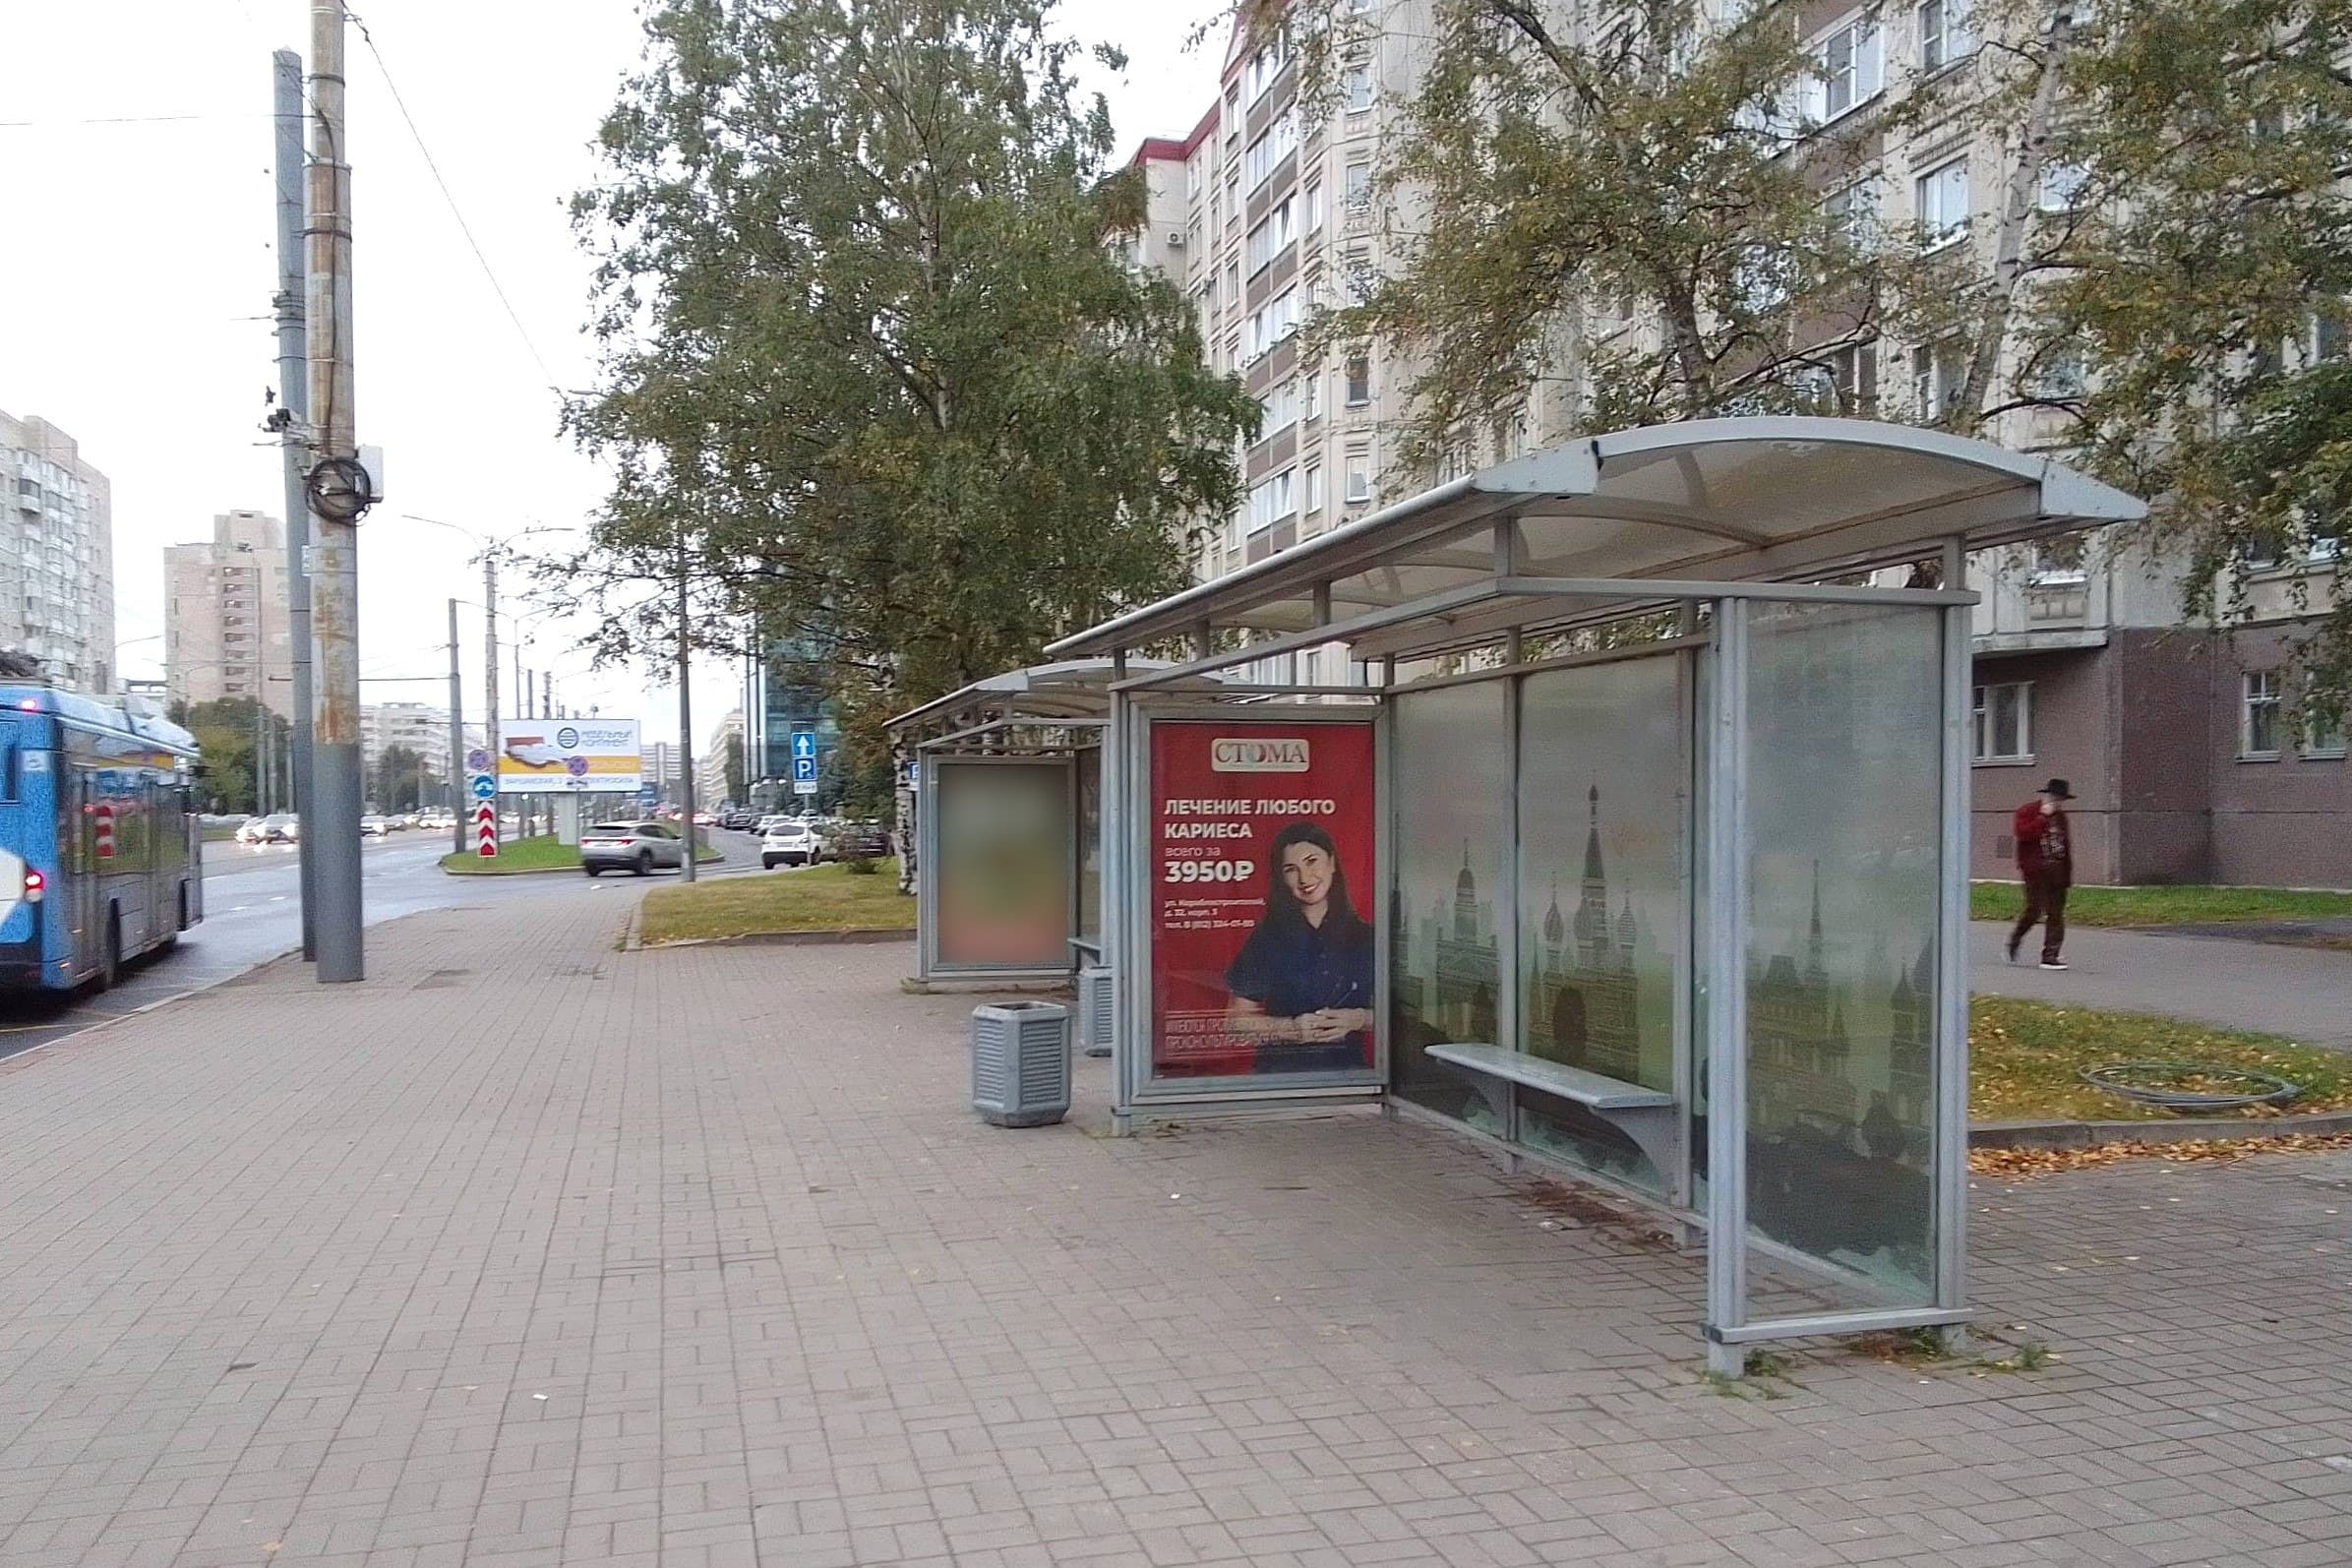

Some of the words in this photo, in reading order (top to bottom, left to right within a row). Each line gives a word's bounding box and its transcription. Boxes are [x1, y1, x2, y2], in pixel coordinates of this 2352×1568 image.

[1216, 743, 1306, 763] СТОМА
[798, 760, 812, 778] P
[1164, 799, 1251, 815] ЛЕЧЕНИЕ
[1254, 799, 1336, 815] ЛЮБОГО
[1164, 822, 1253, 839] КАРИЕСА
[1165, 847, 1203, 857] всего
[1206, 847, 1221, 857] за
[1164, 860, 1254, 882] 3950₽
